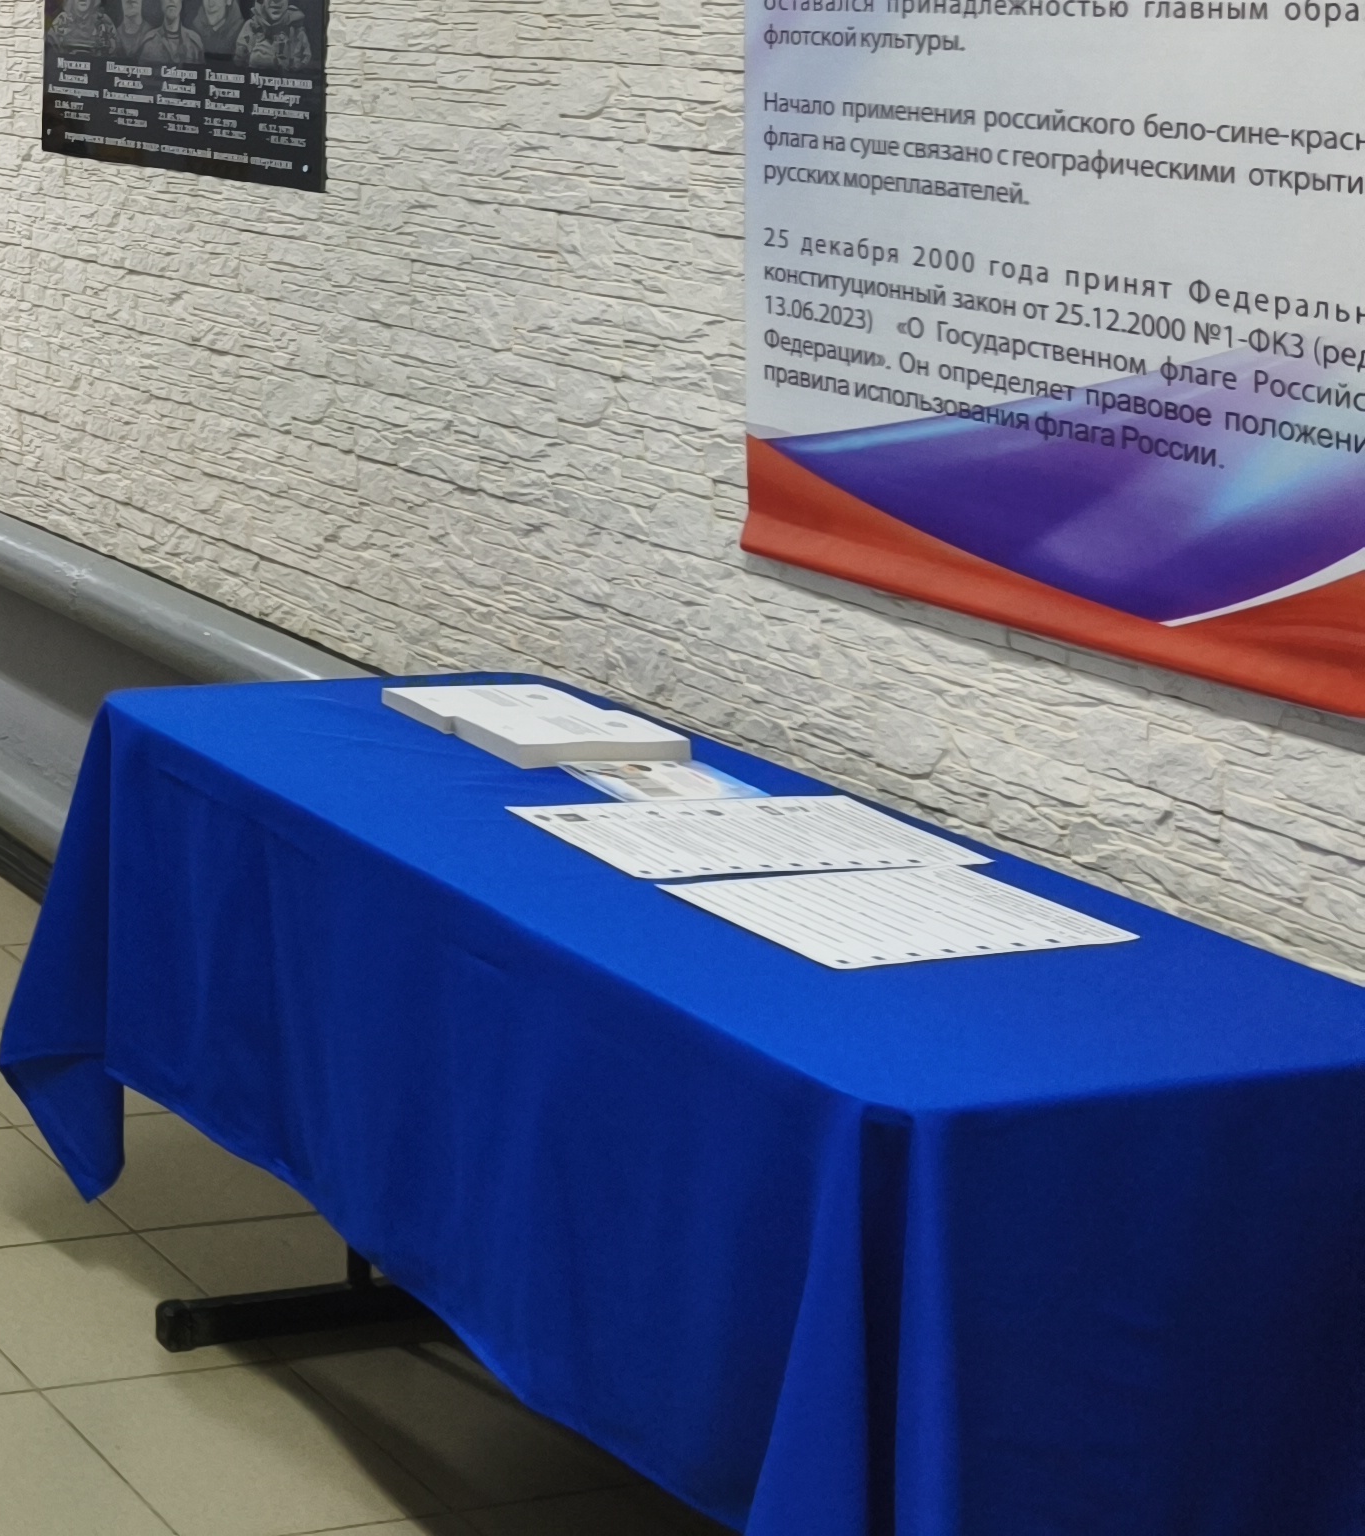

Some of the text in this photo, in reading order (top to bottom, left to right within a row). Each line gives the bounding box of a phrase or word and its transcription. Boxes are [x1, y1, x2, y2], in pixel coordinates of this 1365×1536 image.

[764, 24, 965, 56] флотской культуры.
[1145, 1, 1268, 20] главным
[764, 92, 835, 116] Начало
[842, 102, 975, 125] применения
[984, 109, 1135, 136] российского
[764, 125, 1363, 196] флага на суше связано с географическими открыти
[764, 165, 1030, 205] русских мореплавателей.
[764, 227, 789, 248] 25
[800, 237, 898, 266] декабря
[912, 246, 974, 273] 2000
[989, 260, 1048, 286] года
[1065, 270, 1172, 299] принят
[764, 266, 946, 306] конституционный
[952, 292, 1016, 316] закон
[1023, 303, 1049, 320] от
[1055, 302, 1186, 341] 25.12.2000
[1194, 321, 1304, 358] №1-ФКЗ
[765, 295, 873, 334] 13.06.2023)
[896, 317, 924, 338] «О
[937, 321, 1145, 377] Государственном
[1160, 357, 1237, 390] флаге
[764, 328, 891, 369] Федерации».
[899, 352, 929, 376] Он
[938, 364, 1075, 401] определяет
[1086, 387, 1212, 426] правовое
[764, 365, 1224, 469] правила использования флага России.
